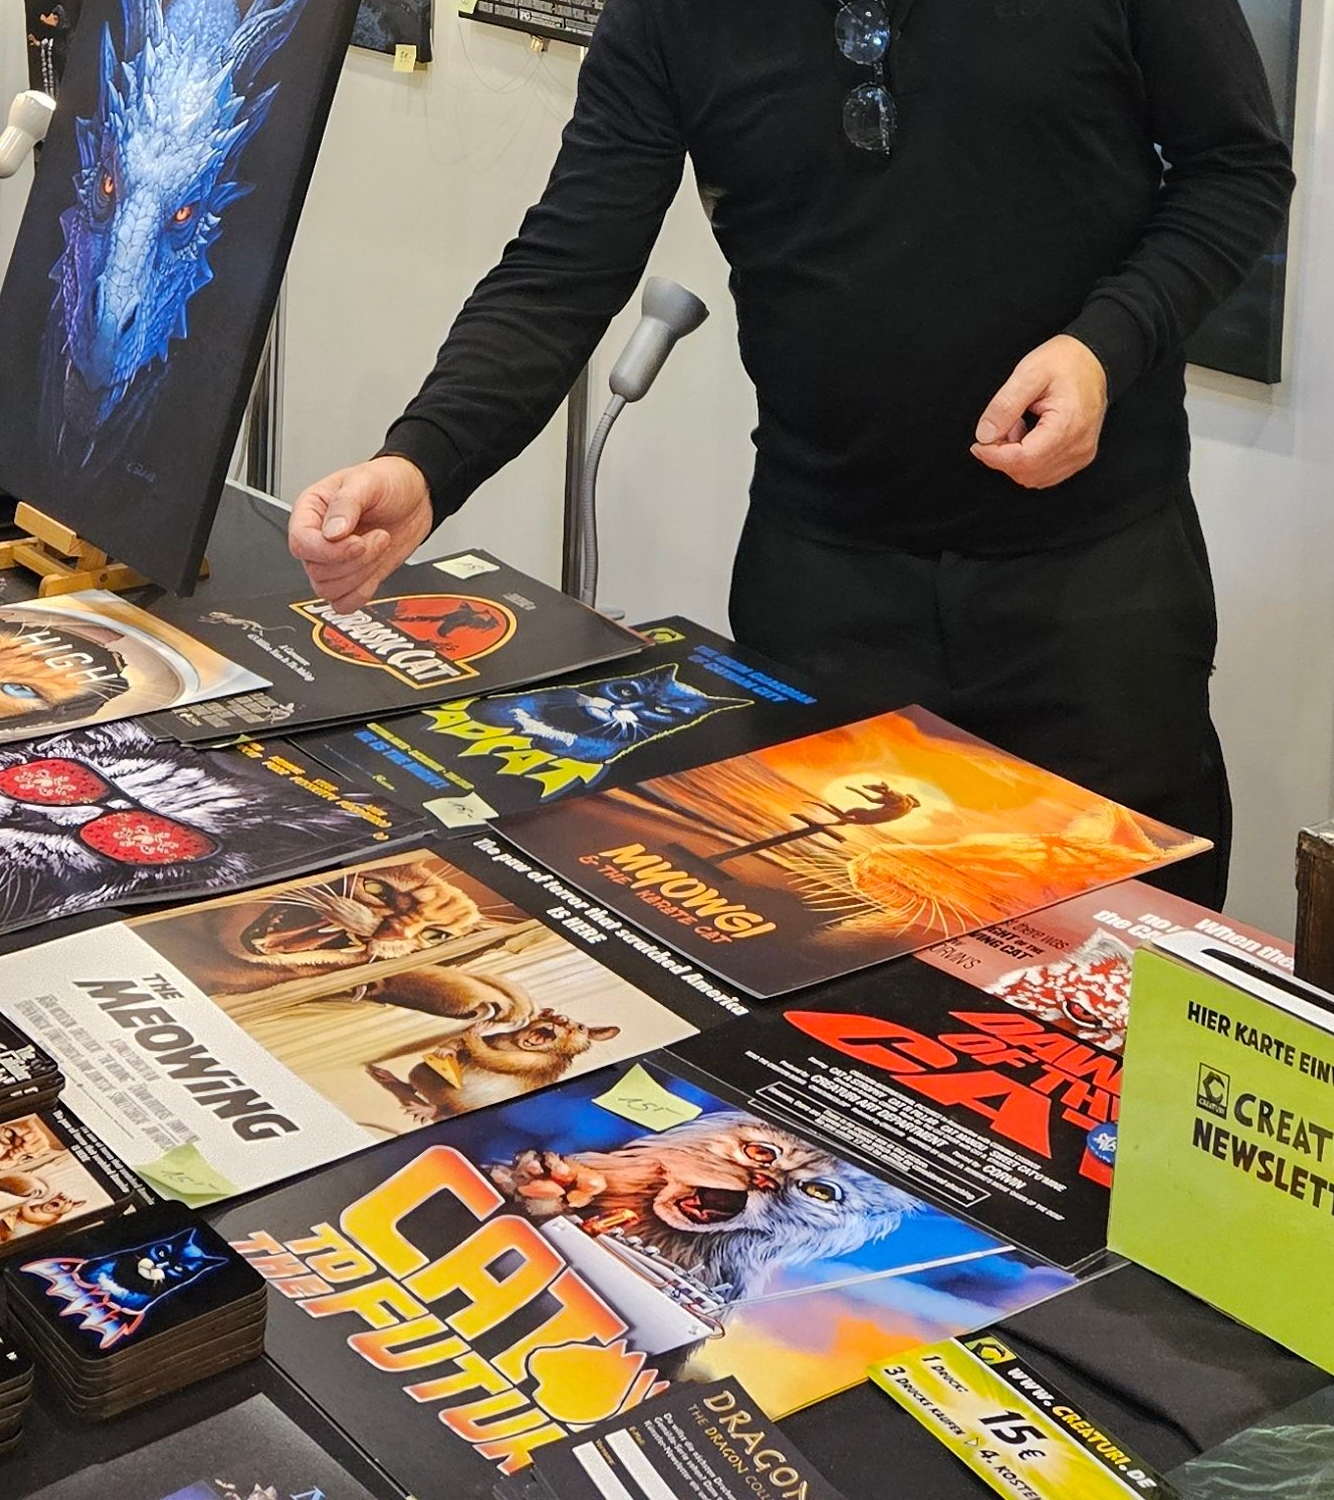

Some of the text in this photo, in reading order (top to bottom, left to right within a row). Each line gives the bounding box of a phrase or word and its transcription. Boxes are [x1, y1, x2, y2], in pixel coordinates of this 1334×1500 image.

[11, 631, 118, 684] HIGH
[387, 649, 461, 681] CAT
[597, 864, 632, 885] THE
[635, 889, 698, 926] KARATE
[693, 925, 733, 944] CAT
[599, 843, 776, 938] MYOWGI
[473, 838, 749, 1016] The paw of terror that scratched America
[546, 906, 607, 944] IS HERE
[999, 943, 1034, 960] CAT
[1195, 918, 1259, 953] When
[142, 973, 184, 1000] THE
[938, 1034, 1038, 1070] OF
[1187, 1001, 1231, 1037] HIER
[1235, 1022, 1296, 1067] KARTE
[877, 1109, 949, 1149] DEPARTMENT
[228, 1231, 335, 1298] THE
[284, 1222, 377, 1284] TO
[340, 1145, 629, 1386] CAT
[883, 1366, 905, 1377] 3
[895, 1378, 932, 1414] DRUCKE
[930, 1403, 966, 1436] KAUFEN
[921, 1355, 969, 1393] 1 DRUCK:
[687, 1404, 749, 1475] THE DRAGON
[979, 1409, 1048, 1461] 15 €
[1007, 1367, 1158, 1489] WWW.CREATURI.DE
